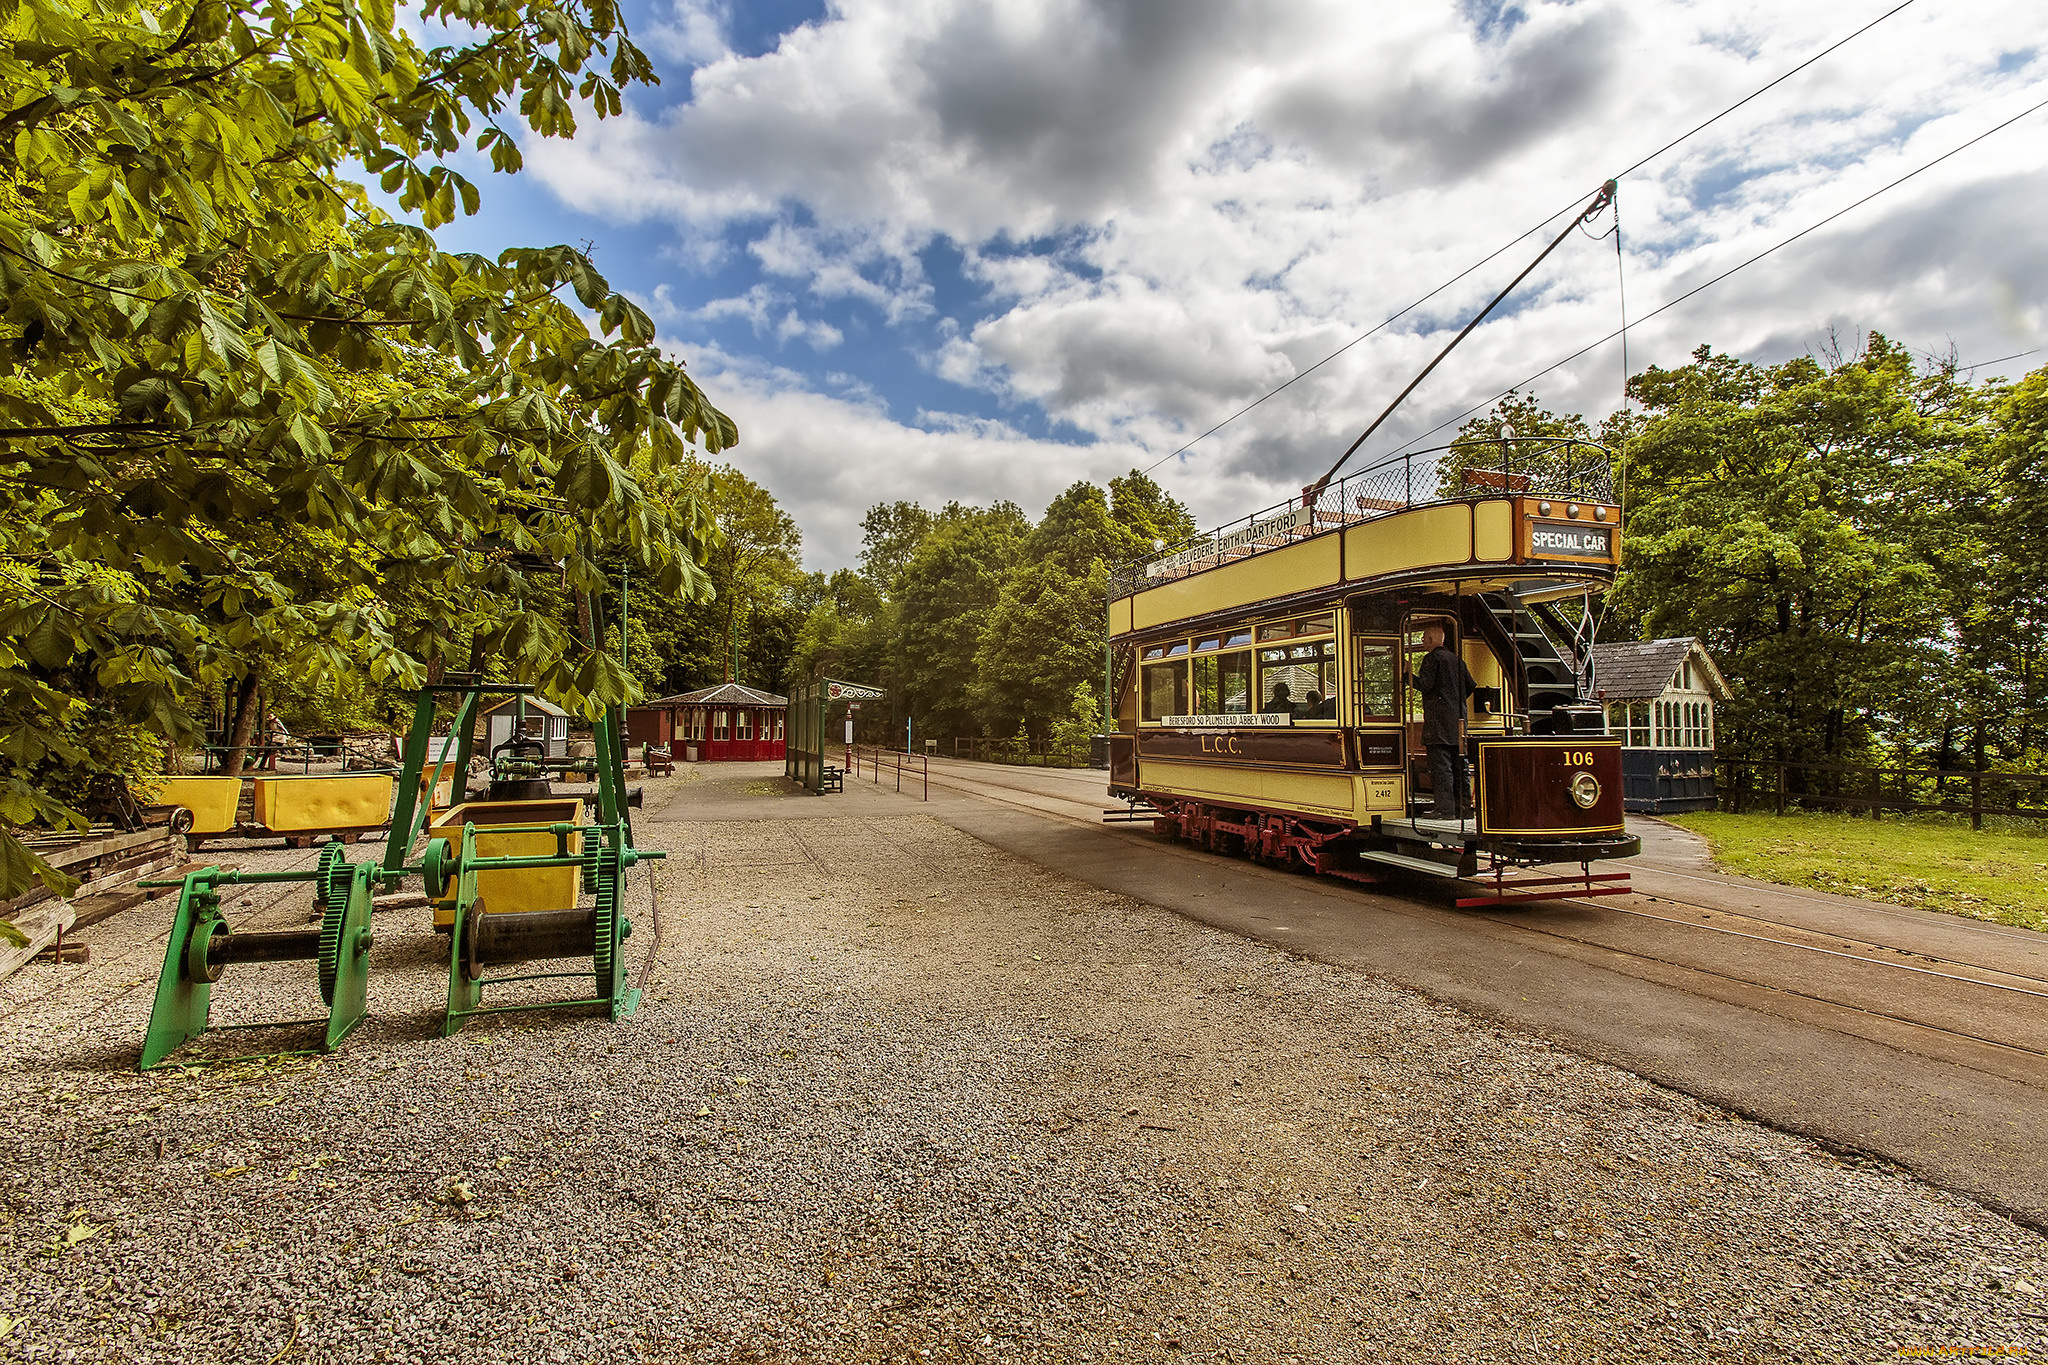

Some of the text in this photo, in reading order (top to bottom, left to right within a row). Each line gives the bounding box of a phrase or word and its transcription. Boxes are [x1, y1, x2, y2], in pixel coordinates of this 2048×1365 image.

[1178, 542, 1214, 566] BELVEDERE
[1217, 534, 1240, 552] ERITH
[1246, 513, 1297, 541] DARTFORD
[1532, 531, 1606, 551] SPECIAL CAR
[1168, 716, 1196, 726] BERESFORD
[1205, 715, 1237, 726] PLUMSTEAD
[1239, 715, 1259, 725] ABBEY
[1260, 714, 1280, 725] WOOD
[1563, 751, 1594, 766] 106
